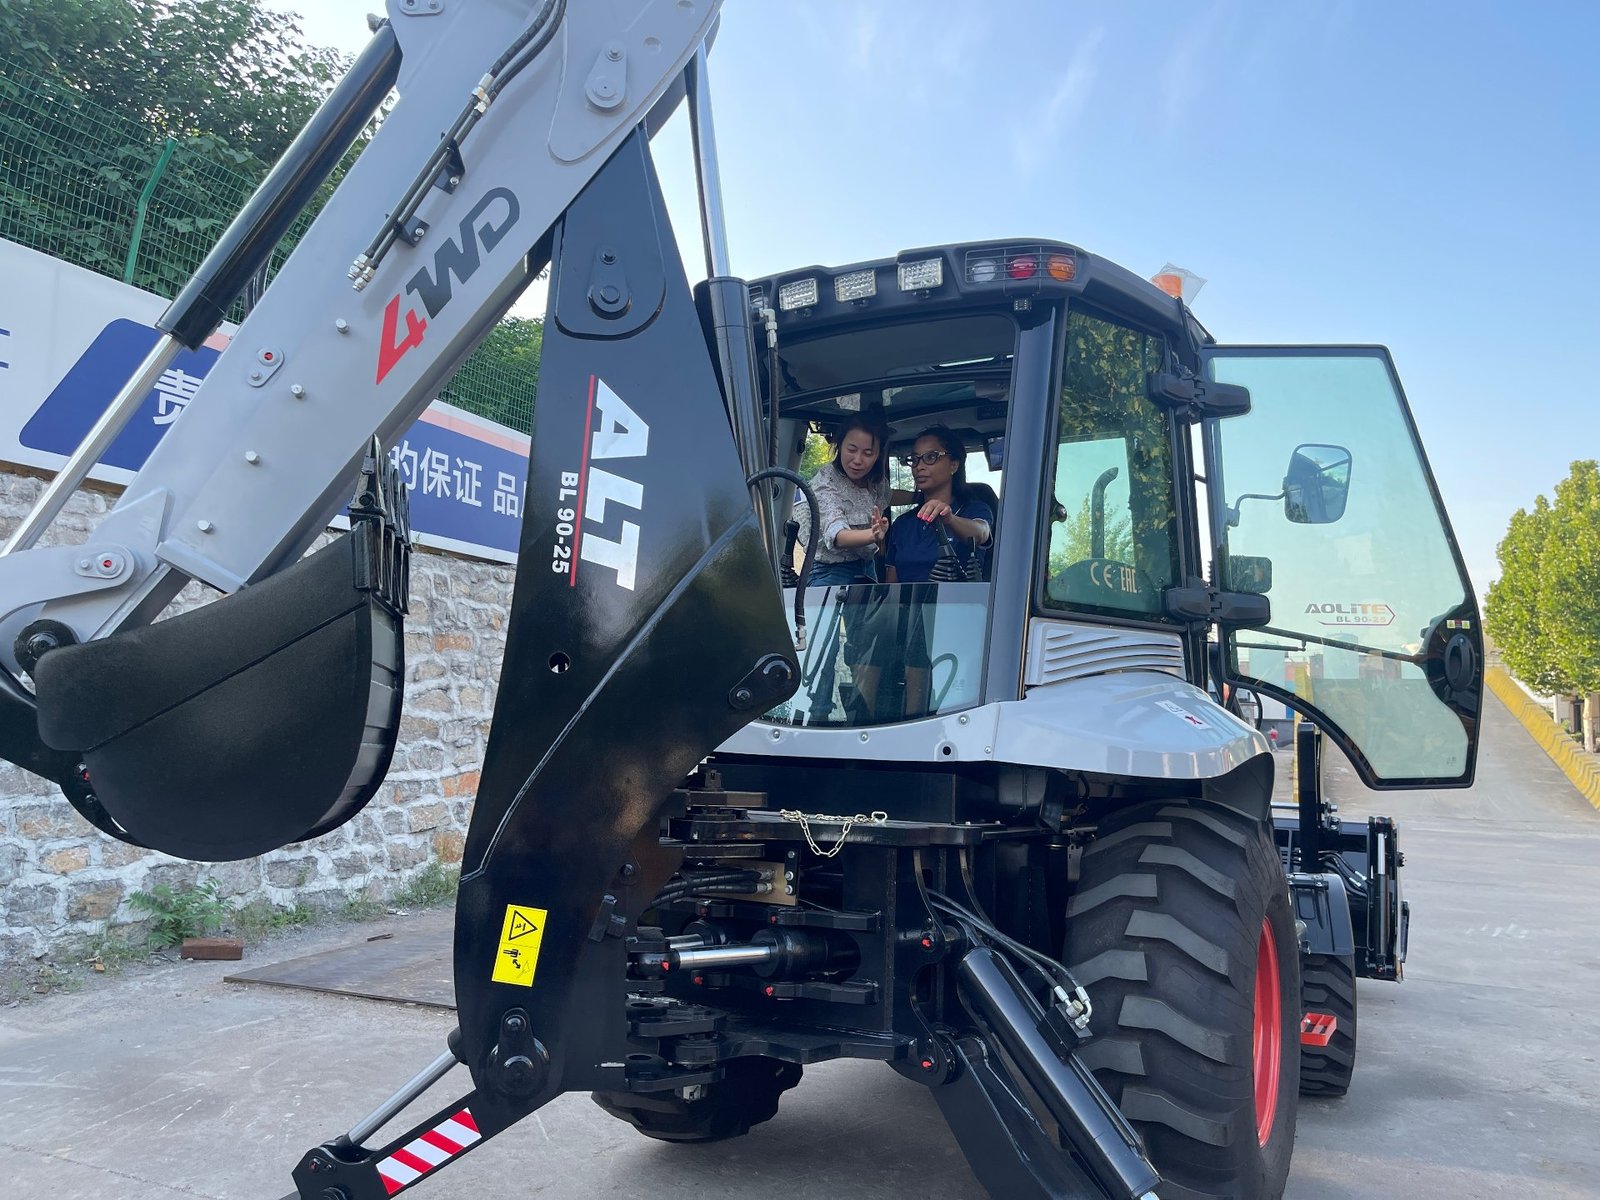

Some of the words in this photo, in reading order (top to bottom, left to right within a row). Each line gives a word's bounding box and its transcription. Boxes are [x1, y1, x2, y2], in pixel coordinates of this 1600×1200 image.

[376, 187, 520, 385] 4WD
[493, 471, 527, 519] 品
[559, 471, 579, 501] BL
[580, 378, 649, 591] ALT
[552, 508, 575, 573] 90-25
[1090, 561, 1113, 589] CE
[1336, 615, 1351, 623] BL
[1354, 615, 1386, 623] 90-25
